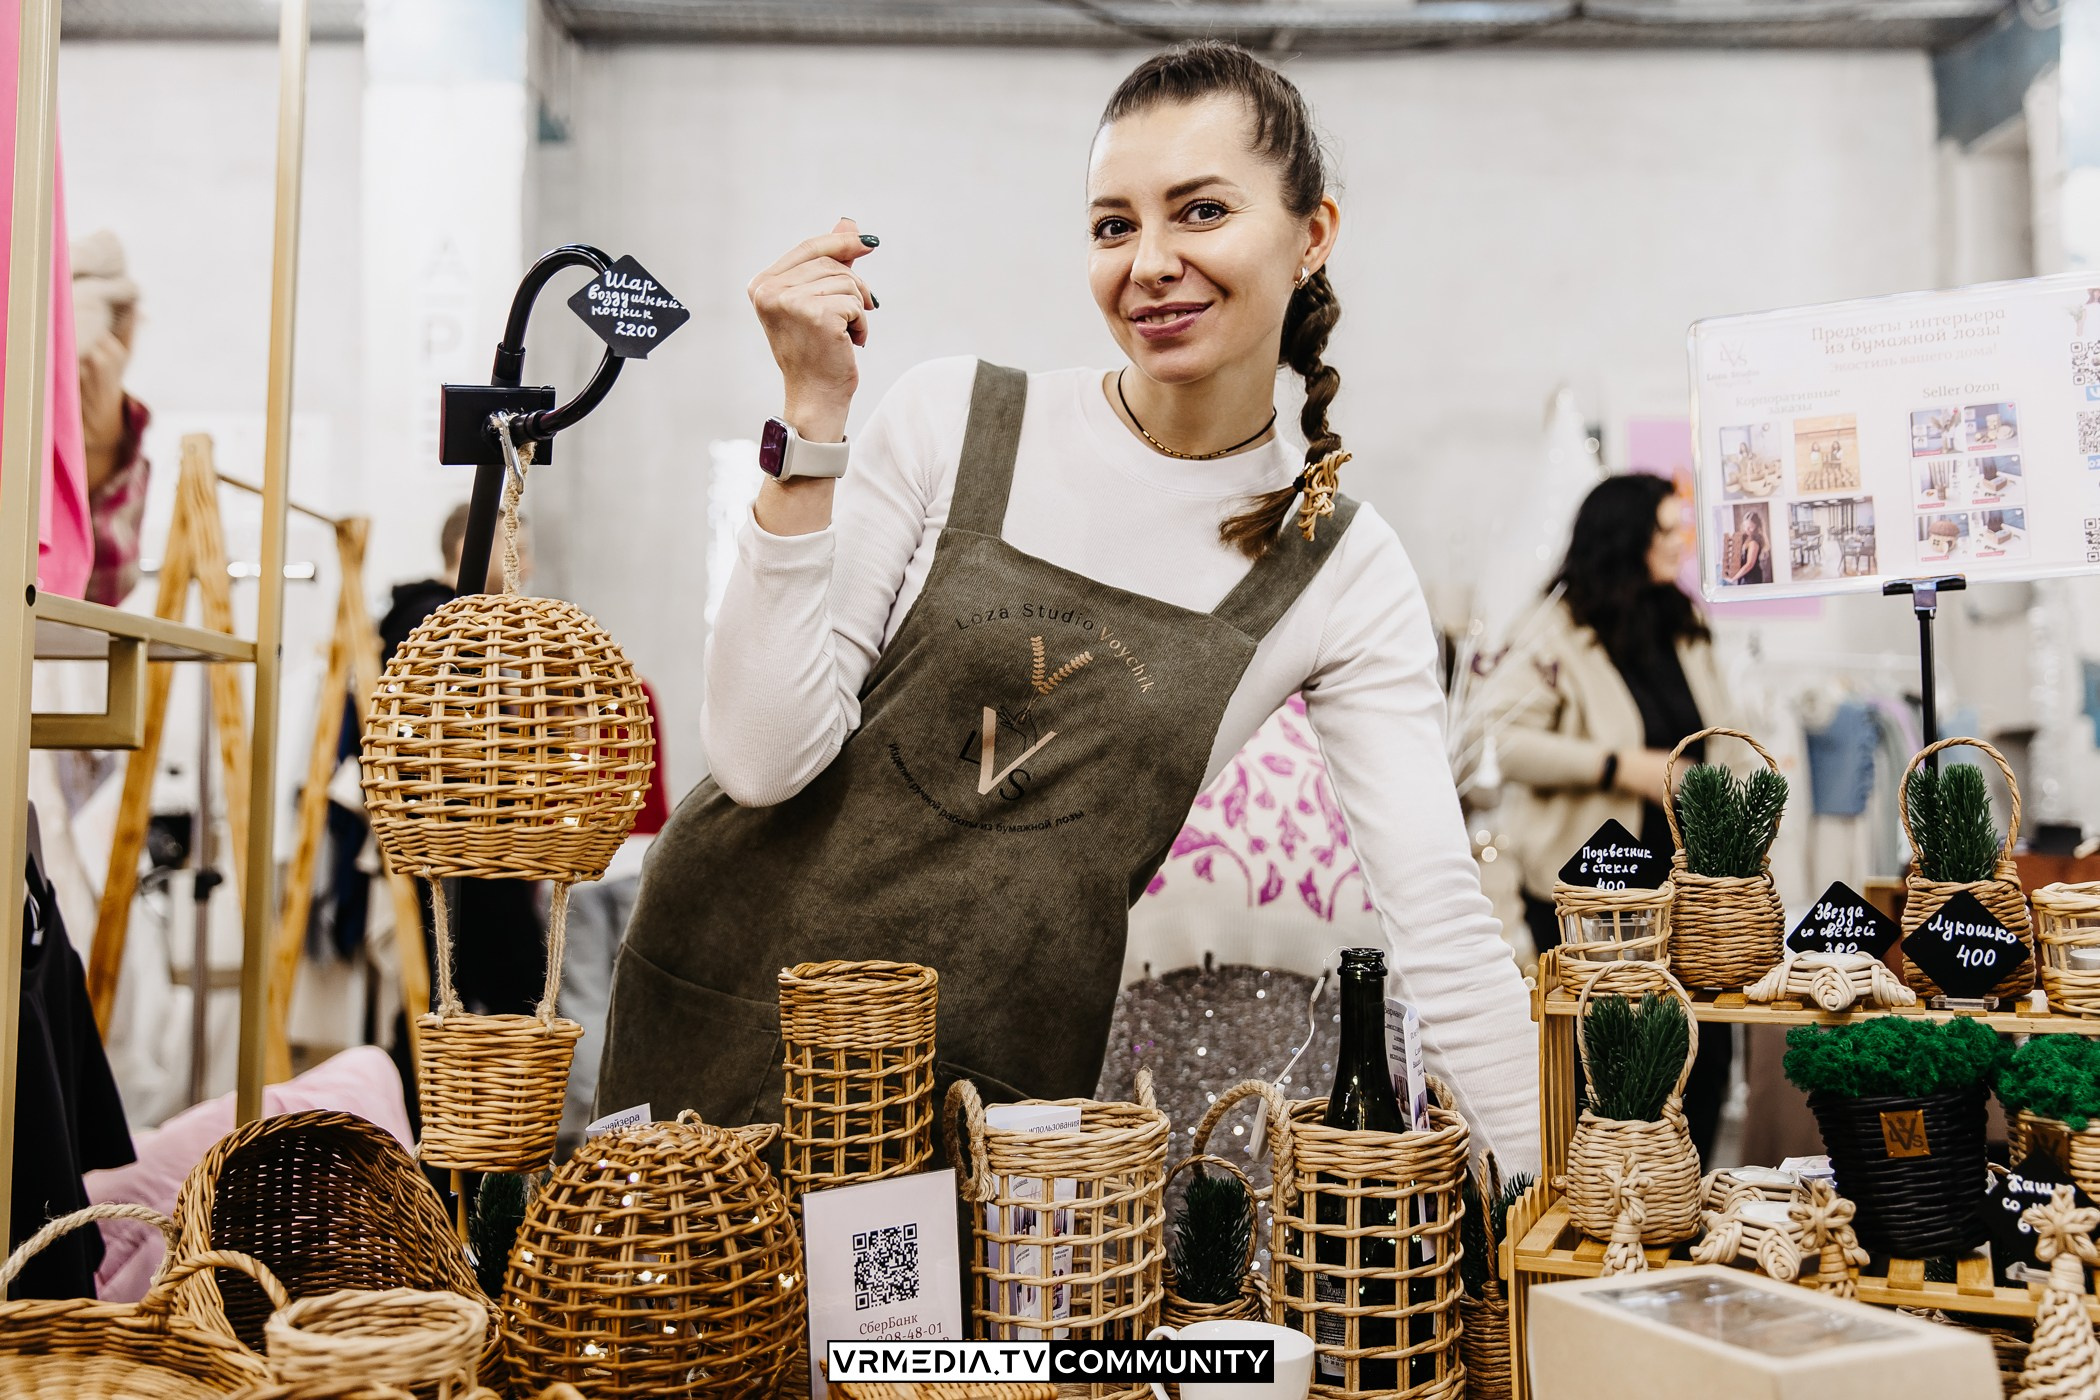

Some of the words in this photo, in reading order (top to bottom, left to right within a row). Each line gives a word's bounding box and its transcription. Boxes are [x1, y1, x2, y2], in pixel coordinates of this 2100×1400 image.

[604, 270, 657, 296] Шар
[591, 305, 653, 320] ночник
[615, 321, 657, 338] 2200
[1811, 322, 1901, 342] Предметы
[1909, 308, 2005, 329] интерьера
[1825, 343, 1845, 354] из
[1851, 329, 1946, 354] бумажной
[1953, 325, 2000, 340] лозы
[1923, 384, 1960, 399] Seller
[1964, 382, 2000, 394] Ozon
[956, 607, 1009, 630] Loza
[1022, 603, 1095, 631] Studio
[1101, 626, 1154, 693] Voychik
[908, 783, 942, 811] ручной
[980, 822, 993, 831] из
[996, 819, 1052, 834] бумажной
[1055, 810, 1084, 827] лозы
[1582, 843, 1653, 863] Подсвечник
[1580, 862, 1588, 873] в
[1592, 864, 1638, 874] стекле
[1814, 902, 1864, 927] Звезда
[1820, 920, 1876, 938] свечей
[1928, 914, 2017, 944] Лукошко
[1956, 944, 1996, 967] 400
[601, 1113, 640, 1130] найзера
[859, 1314, 918, 1335] СберБанк
